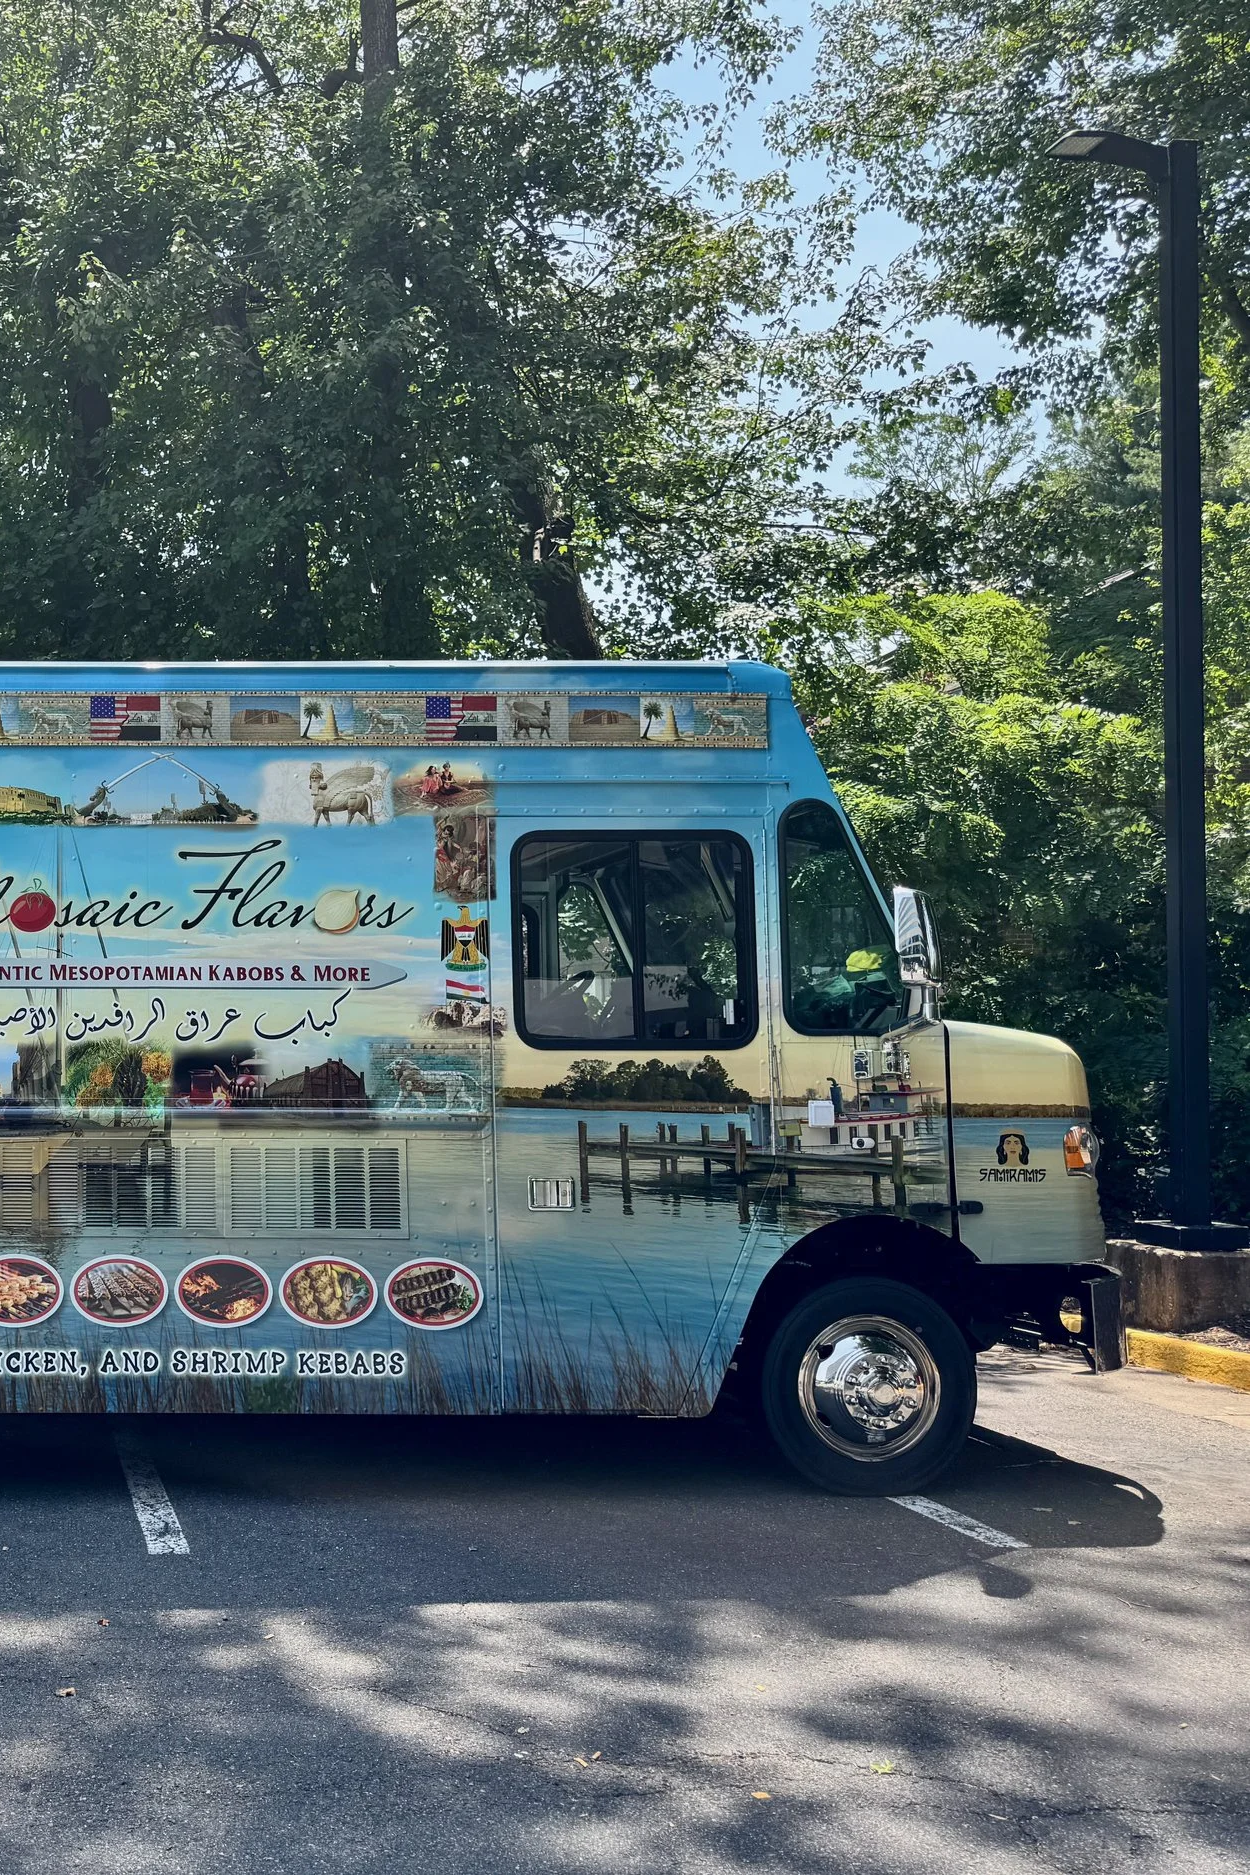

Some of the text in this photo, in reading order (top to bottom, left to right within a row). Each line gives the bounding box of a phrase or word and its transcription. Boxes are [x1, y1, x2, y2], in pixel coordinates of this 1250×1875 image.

[178, 839, 415, 934] Flavors
[49, 963, 202, 982] MESOPOTAMIAN
[208, 963, 285, 983] KABOBS
[290, 964, 307, 982] &
[314, 964, 371, 983] MORE
[65, 996, 167, 1042] الرافدين
[174, 1006, 243, 1043] عراق
[253, 986, 353, 1046] كباب
[99, 1349, 160, 1374] AND
[171, 1349, 287, 1375] SHRIMP
[297, 1351, 407, 1376] KEBABS
